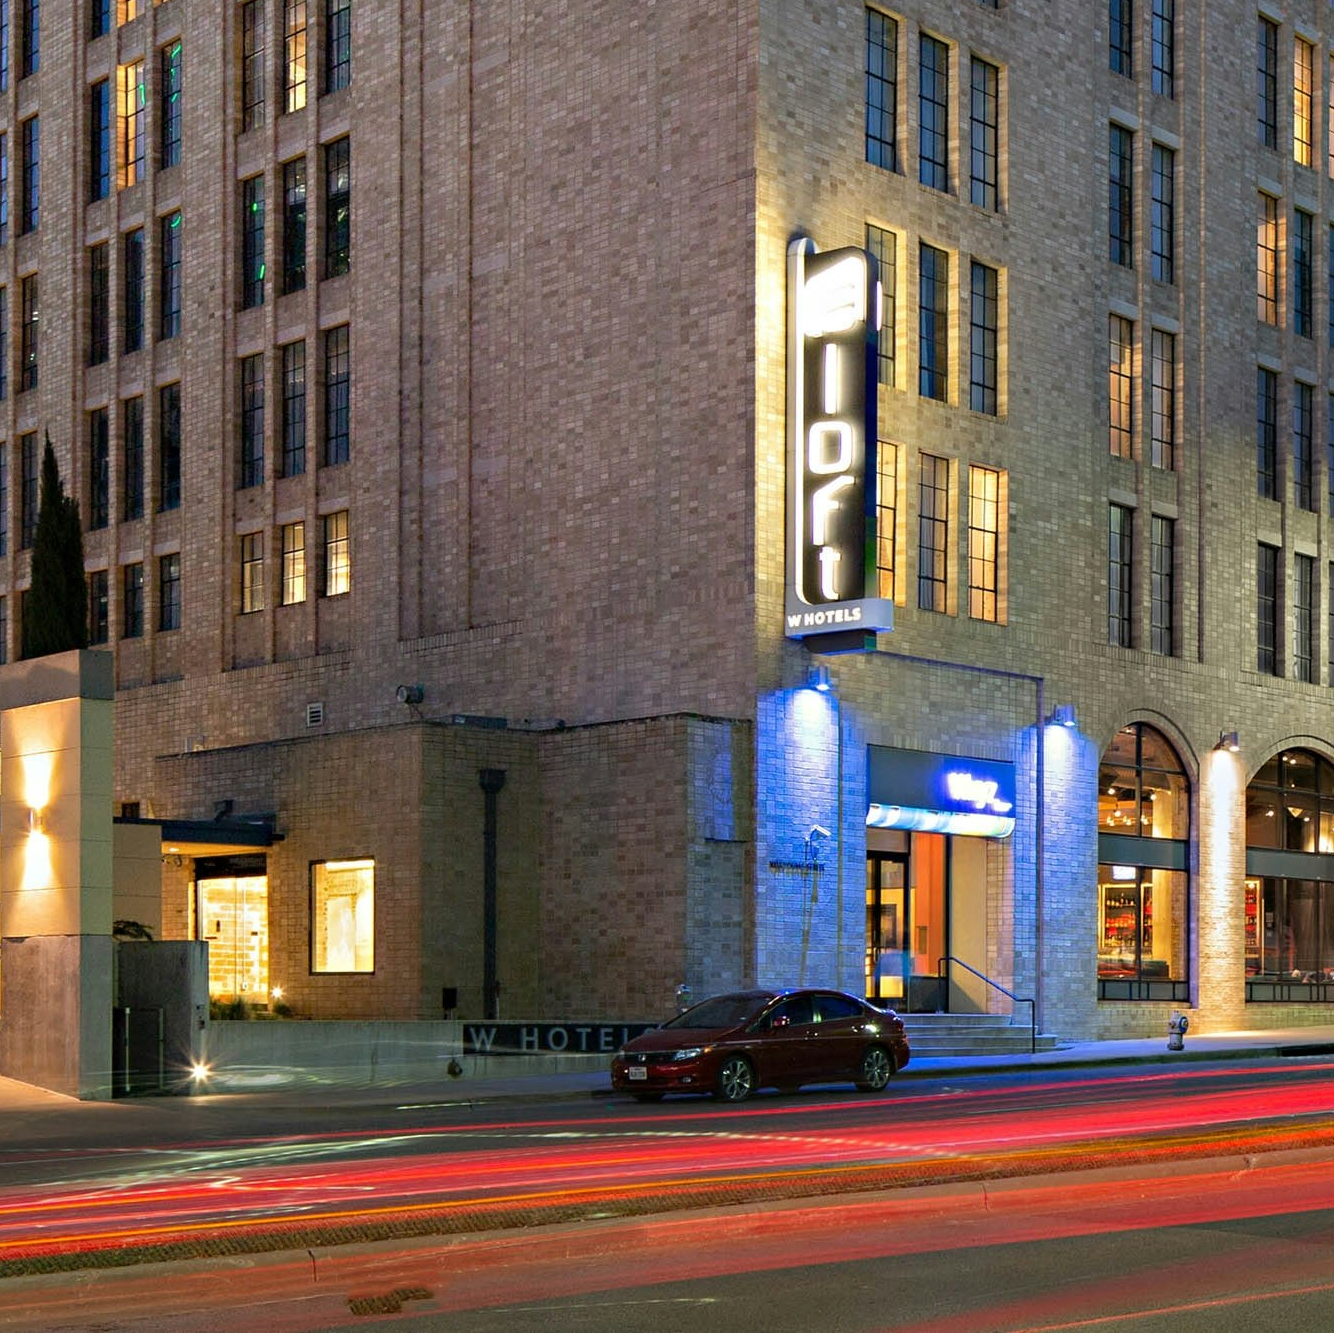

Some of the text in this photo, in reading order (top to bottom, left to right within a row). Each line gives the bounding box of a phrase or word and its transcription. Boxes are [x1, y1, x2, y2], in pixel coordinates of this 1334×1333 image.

[787, 607, 861, 628] W HOTELS
[470, 1027, 657, 1051] W HOTEL
